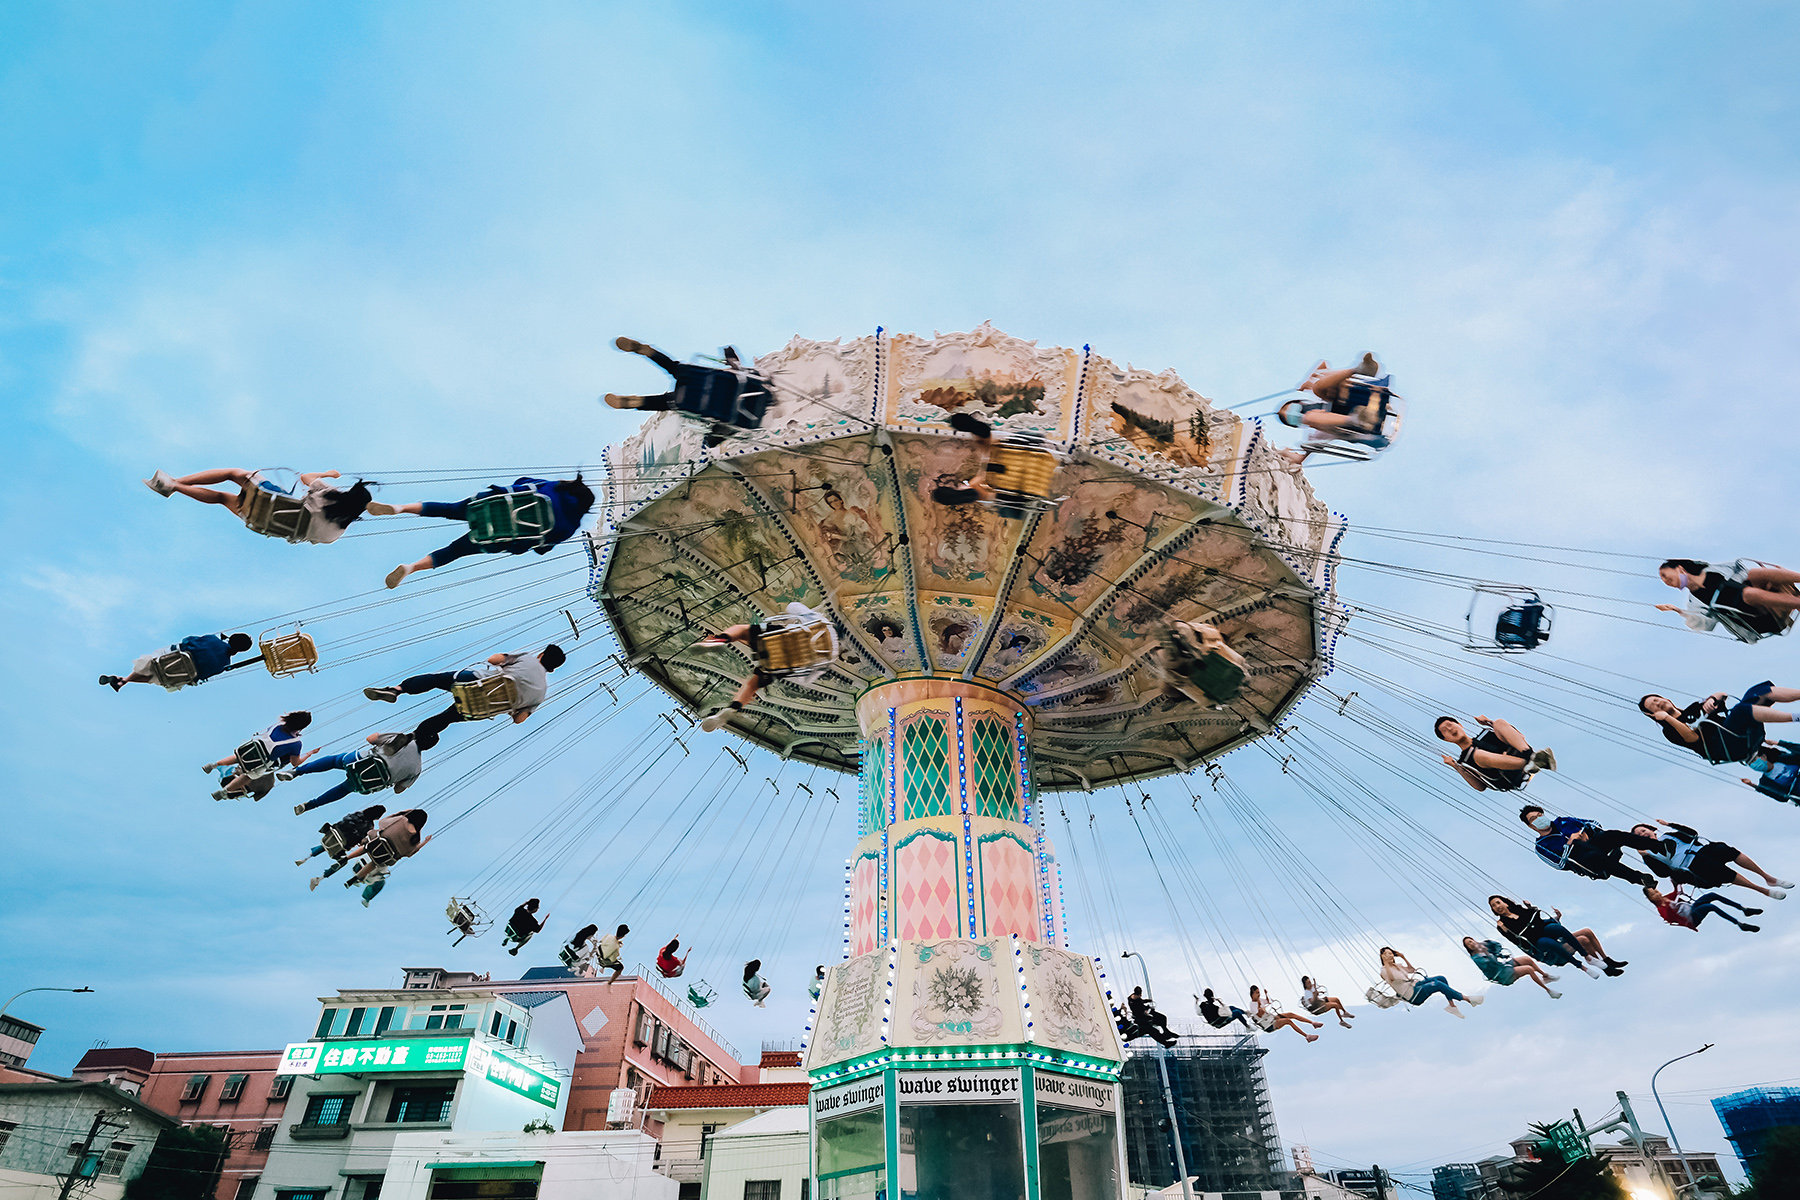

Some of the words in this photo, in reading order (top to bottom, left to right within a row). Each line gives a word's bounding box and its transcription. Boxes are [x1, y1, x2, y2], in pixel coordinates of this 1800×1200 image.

[292, 1048, 314, 1059] 住商
[323, 1046, 410, 1067] 住商不動產
[898, 1076, 942, 1094] wave
[947, 1074, 1018, 1095] swinger
[1035, 1076, 1065, 1094] wave
[1068, 1081, 1112, 1107] swinger
[815, 1094, 840, 1112] wave
